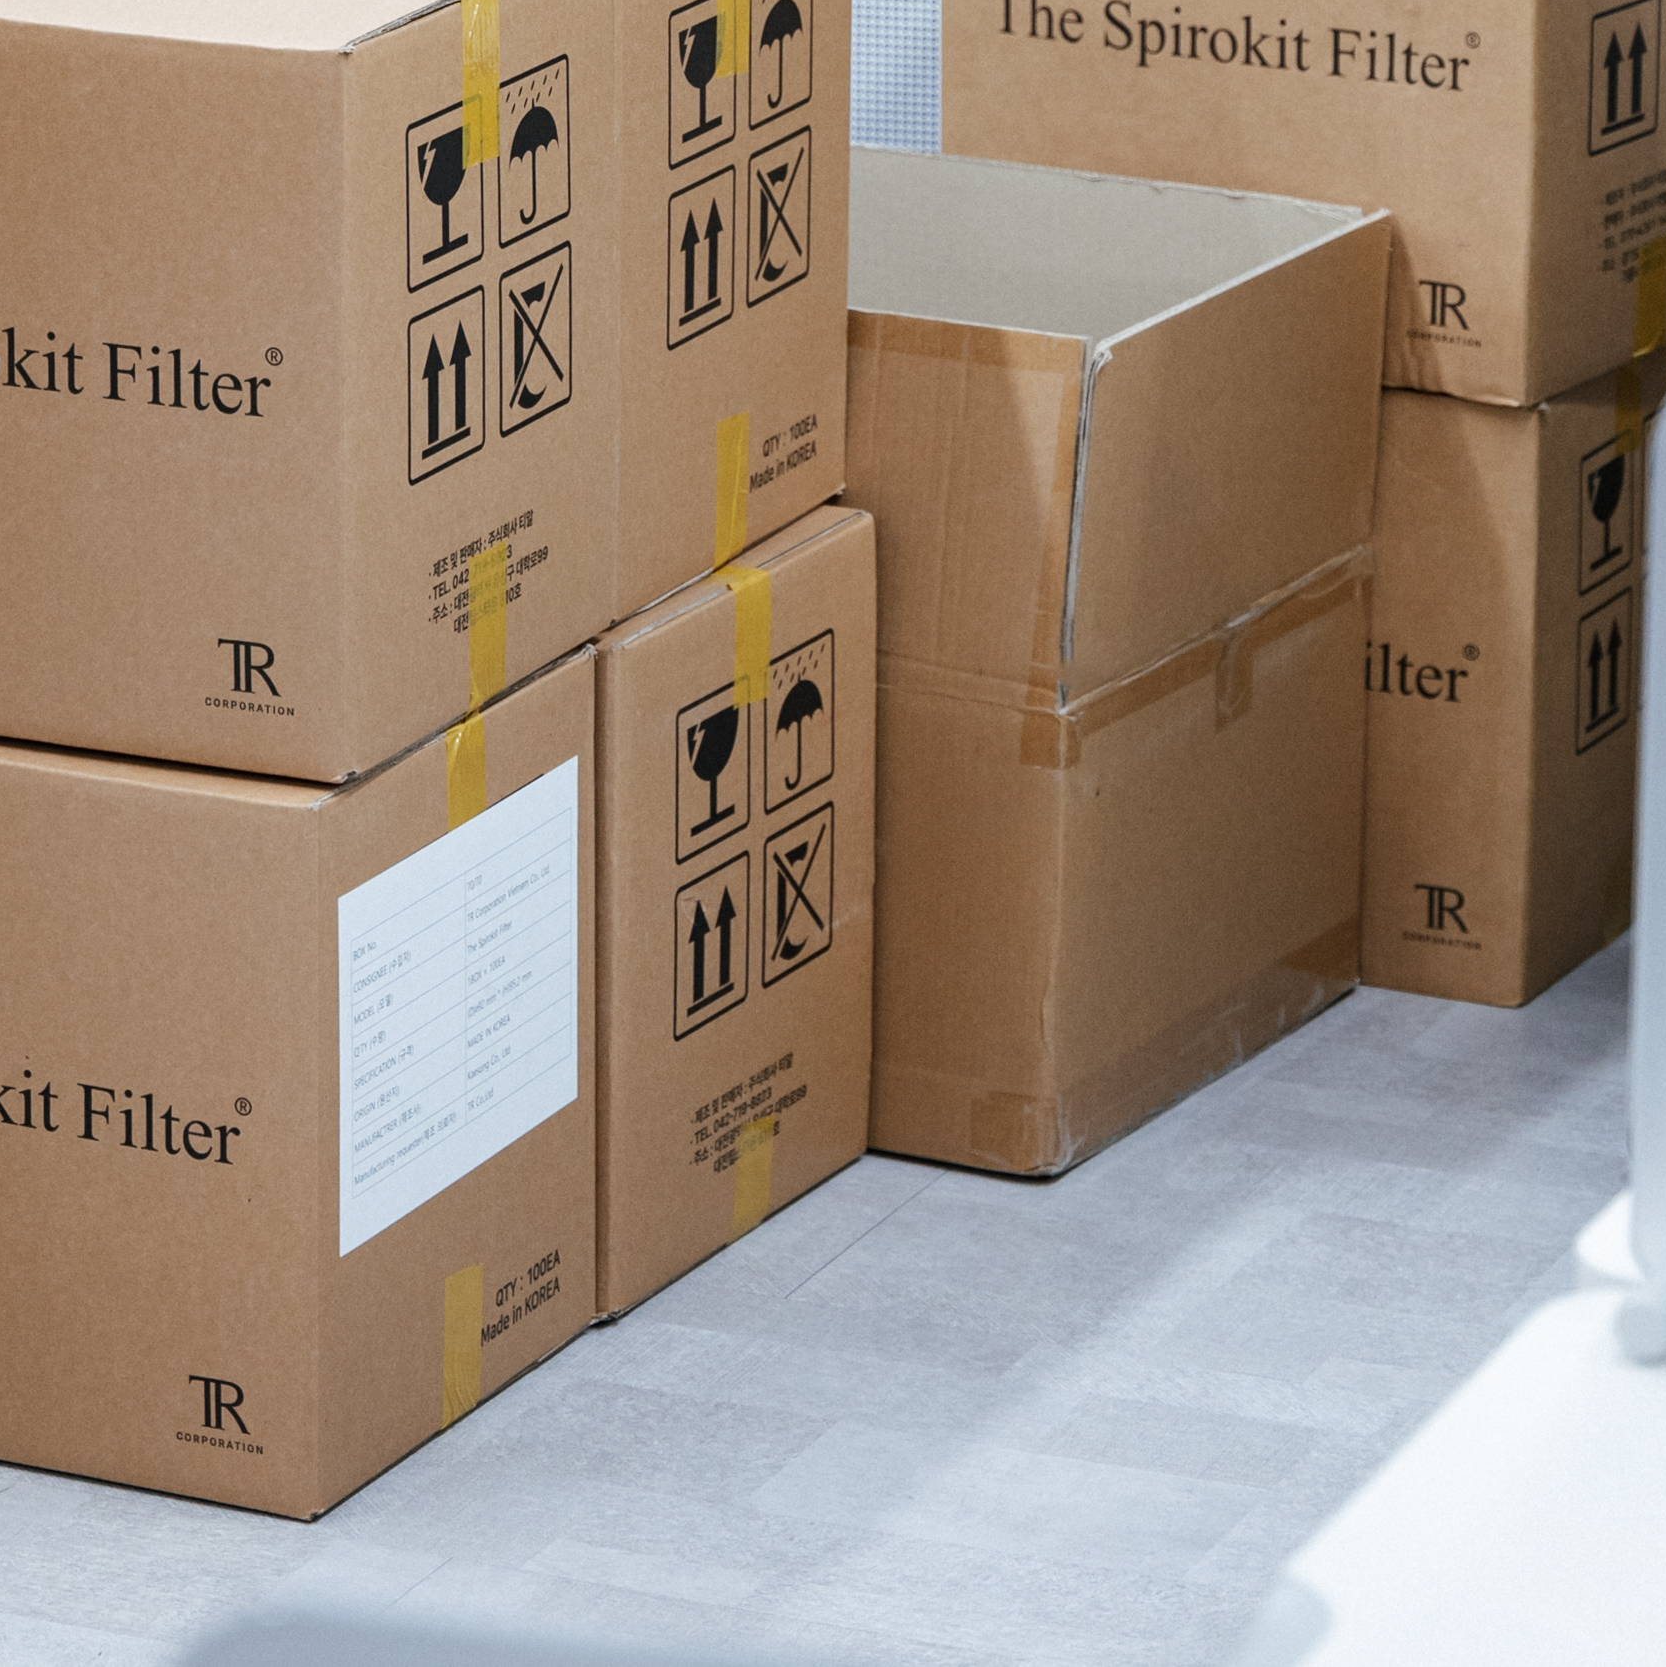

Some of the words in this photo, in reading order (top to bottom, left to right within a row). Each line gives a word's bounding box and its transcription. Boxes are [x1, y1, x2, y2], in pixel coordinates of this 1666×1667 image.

[488, 517, 518, 547] 주식회사
[204, 696, 295, 717] CORPORATION
[496, 1277, 517, 1307] QTY
[527, 1249, 560, 1285] 100EA
[481, 1314, 510, 1347] Made
[513, 1305, 522, 1325] in
[525, 1276, 560, 1316] KOREA
[175, 1430, 264, 1455] CORPORATION
